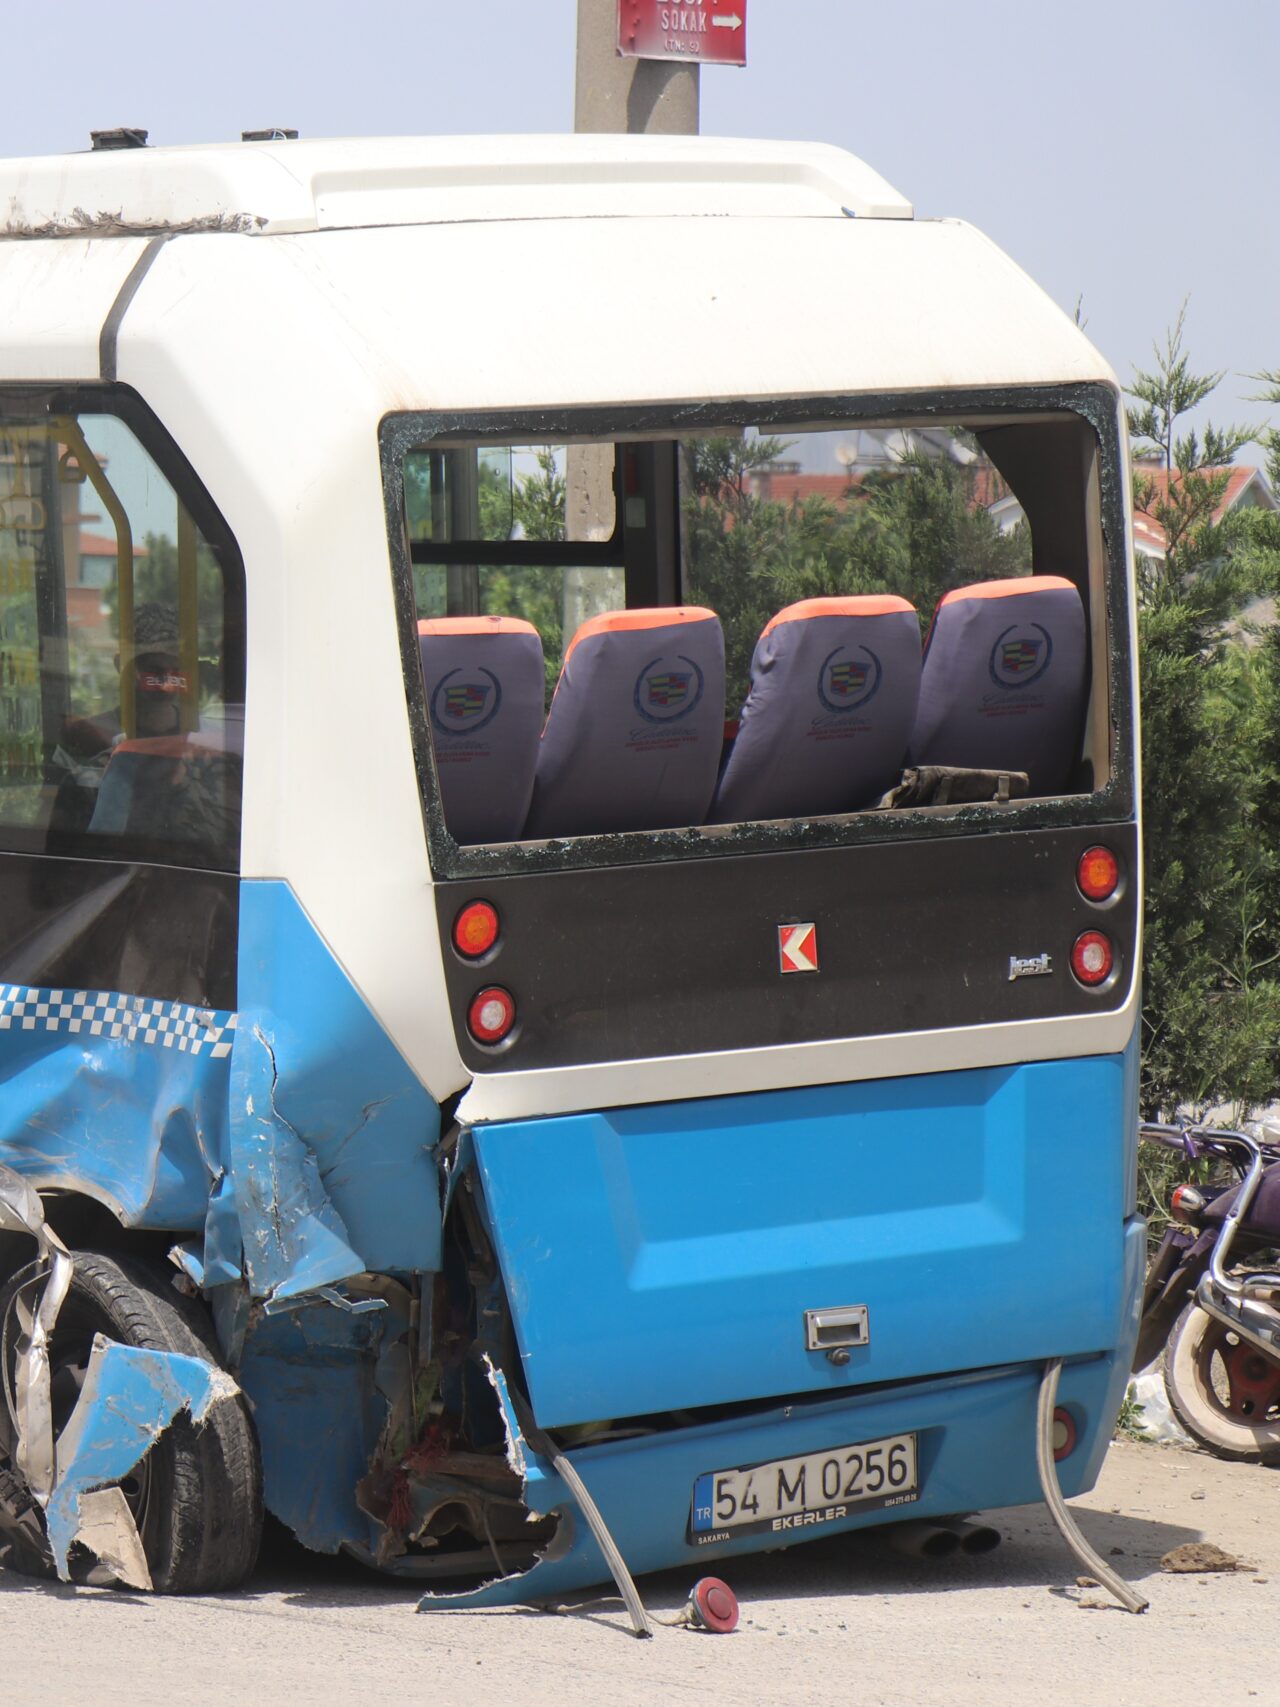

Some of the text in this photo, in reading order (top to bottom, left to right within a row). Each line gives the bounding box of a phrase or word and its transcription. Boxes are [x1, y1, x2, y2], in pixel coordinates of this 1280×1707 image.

[661, 9, 707, 32] SOKAK
[716, 1443, 908, 1521] 54 M 0256
[696, 1507, 711, 1521] TR
[772, 1505, 848, 1531] EKERLER
[698, 1532, 731, 1545] SAKARYA
